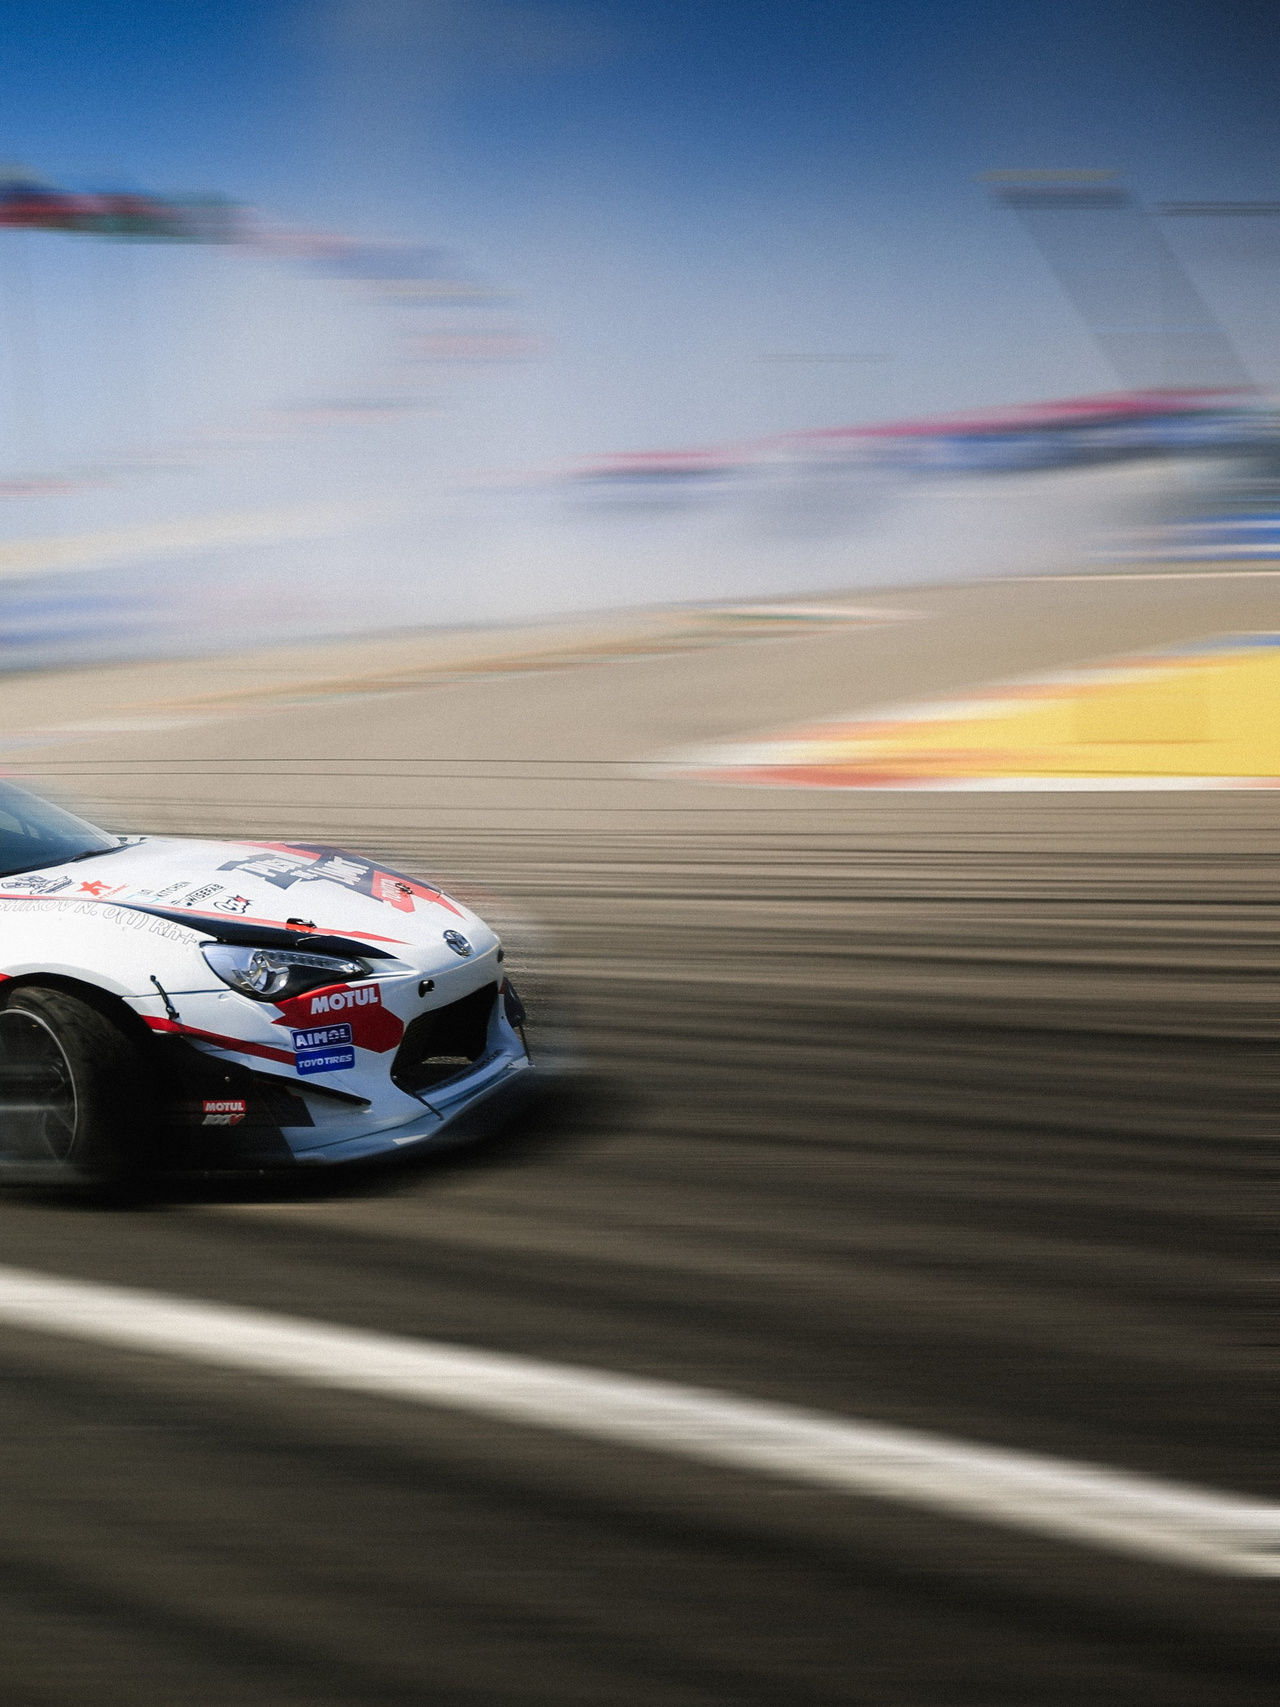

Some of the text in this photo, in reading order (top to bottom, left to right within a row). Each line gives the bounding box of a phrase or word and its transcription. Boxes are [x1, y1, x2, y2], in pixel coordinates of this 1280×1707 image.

[149, 919, 198, 945] Rh+
[310, 987, 379, 1015] MOTUL
[296, 1029, 350, 1047] AIMOL
[298, 1054, 353, 1069] TOYO TIRES
[205, 1102, 244, 1111] MOTUL
